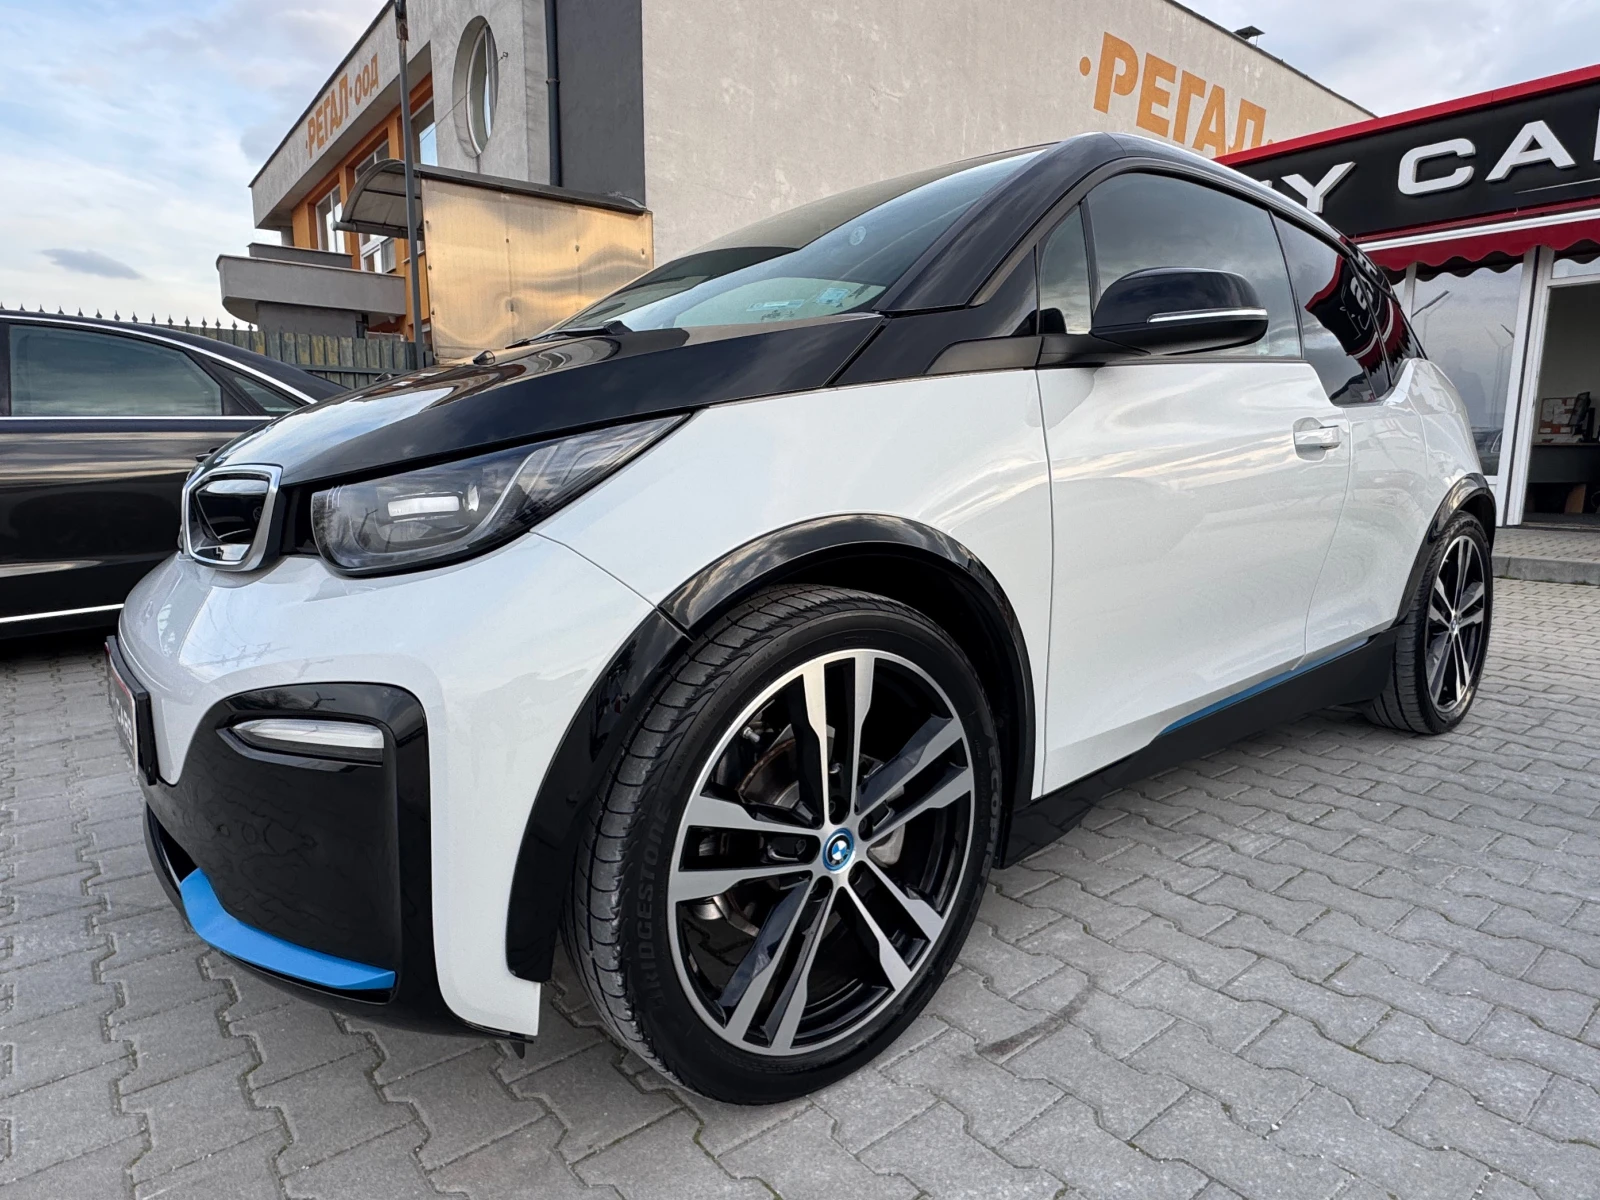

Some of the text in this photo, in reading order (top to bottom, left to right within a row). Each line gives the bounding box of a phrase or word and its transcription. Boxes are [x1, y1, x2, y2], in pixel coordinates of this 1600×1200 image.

[307, 72, 349, 160] РЕГАЛ
[1093, 31, 1267, 156] РЕГАЛ
[1397, 108, 1600, 196] CA
